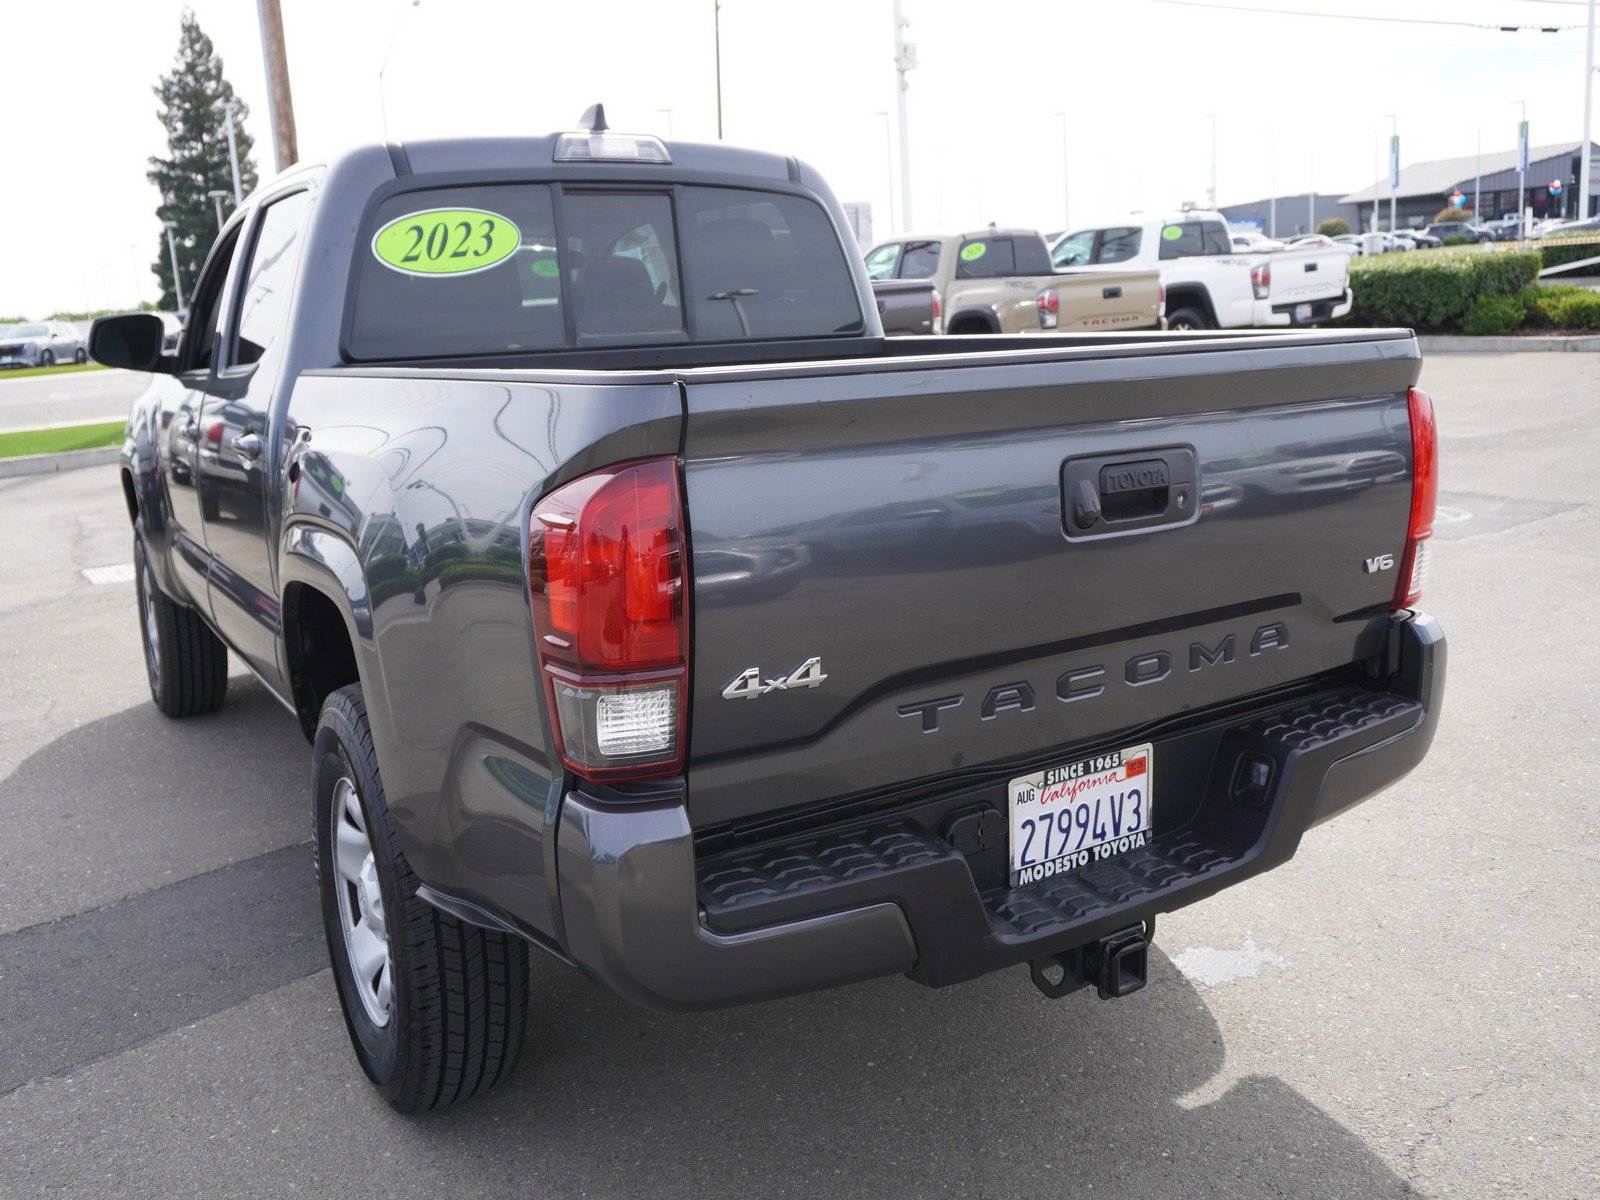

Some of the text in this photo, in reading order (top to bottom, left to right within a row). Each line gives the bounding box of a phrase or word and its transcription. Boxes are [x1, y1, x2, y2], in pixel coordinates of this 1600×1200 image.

[400, 219, 495, 263] 2023
[1081, 315, 1139, 326] TACOMA
[1107, 468, 1167, 491] TOYOTA
[1364, 553, 1394, 573] V6
[896, 621, 1290, 734] TACOMA
[1046, 753, 1120, 785] SINCE 1965
[1016, 789, 1035, 805] AUG
[1039, 771, 1126, 805] California
[1020, 788, 1142, 867] 27994V3
[1019, 833, 1146, 885] MODESTO TOYOTA
